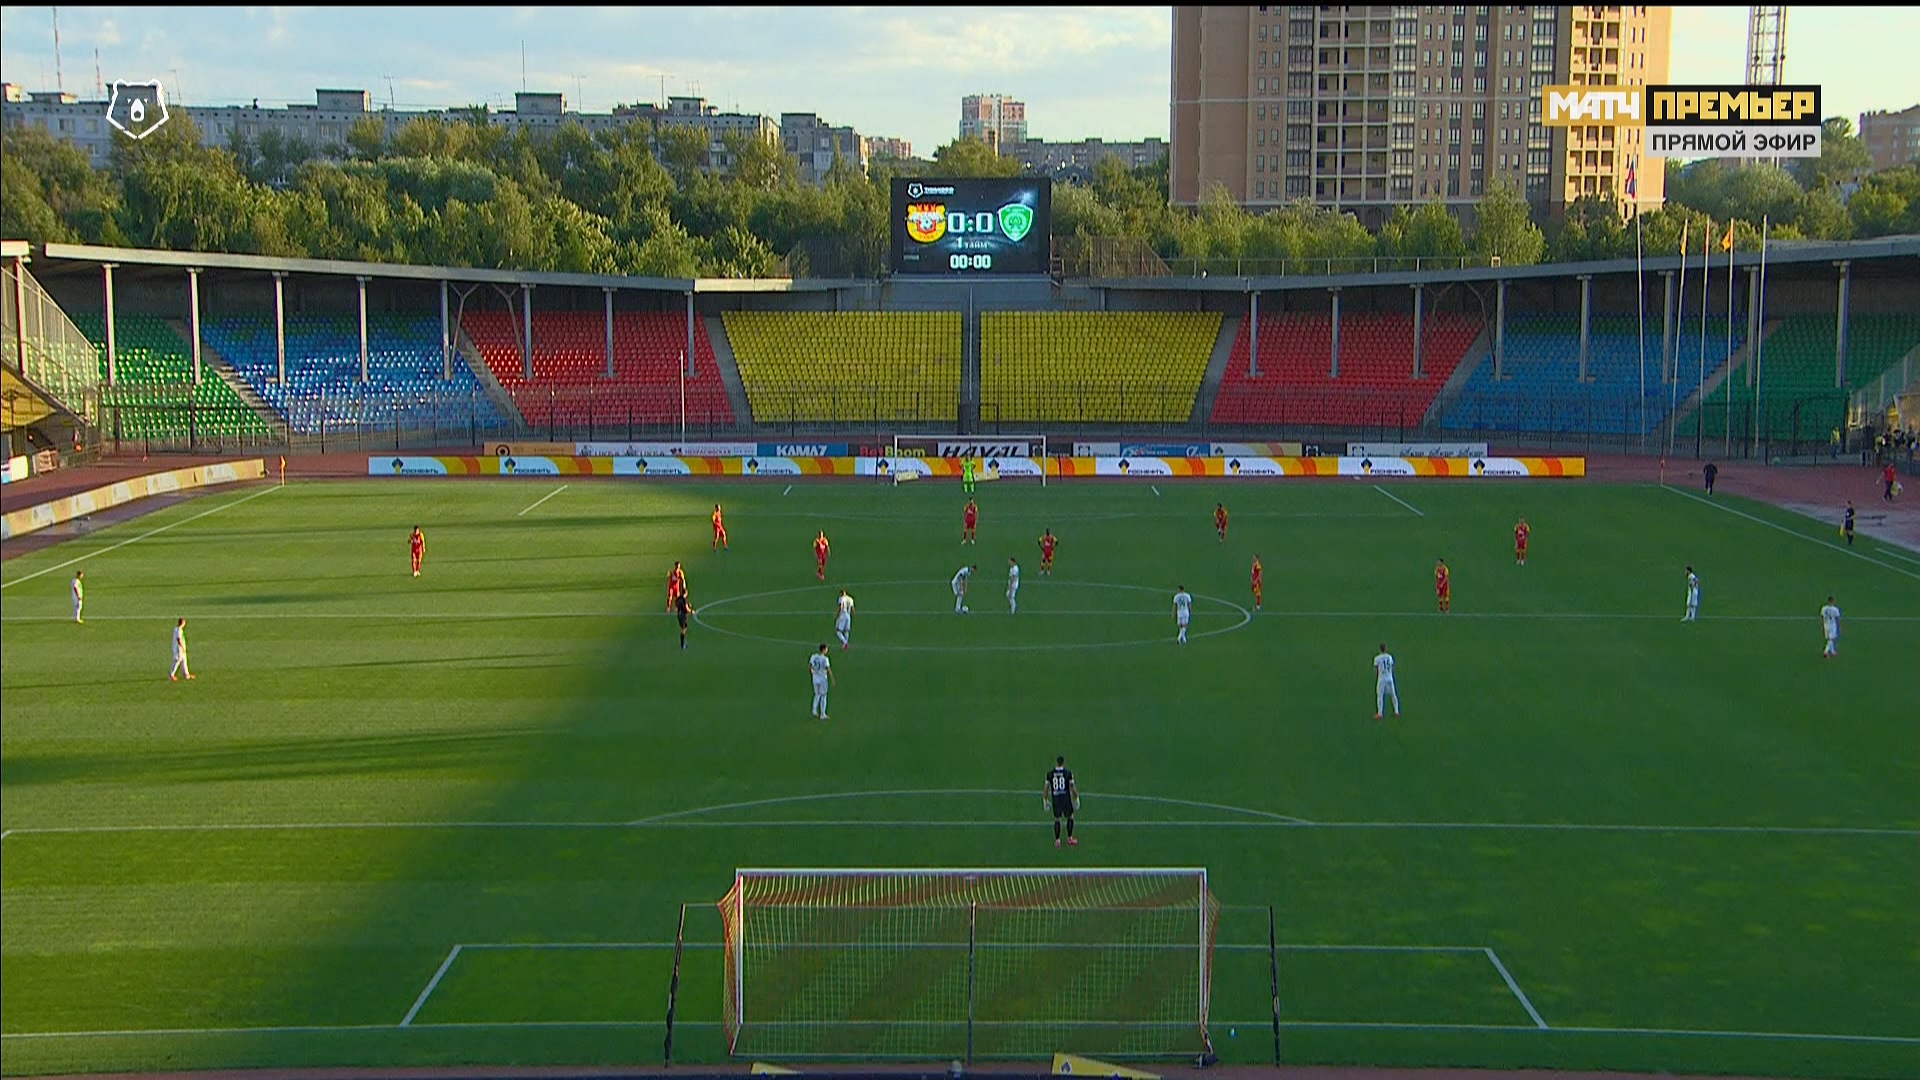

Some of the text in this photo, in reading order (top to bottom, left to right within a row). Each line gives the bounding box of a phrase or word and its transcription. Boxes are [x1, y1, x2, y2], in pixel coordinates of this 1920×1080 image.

[947, 212, 994, 234] 0:0
[950, 254, 991, 269] 00:00
[776, 445, 827, 457] KAMAZ
[942, 446, 1024, 457] HAVAL
[1052, 776, 1065, 790] 88
